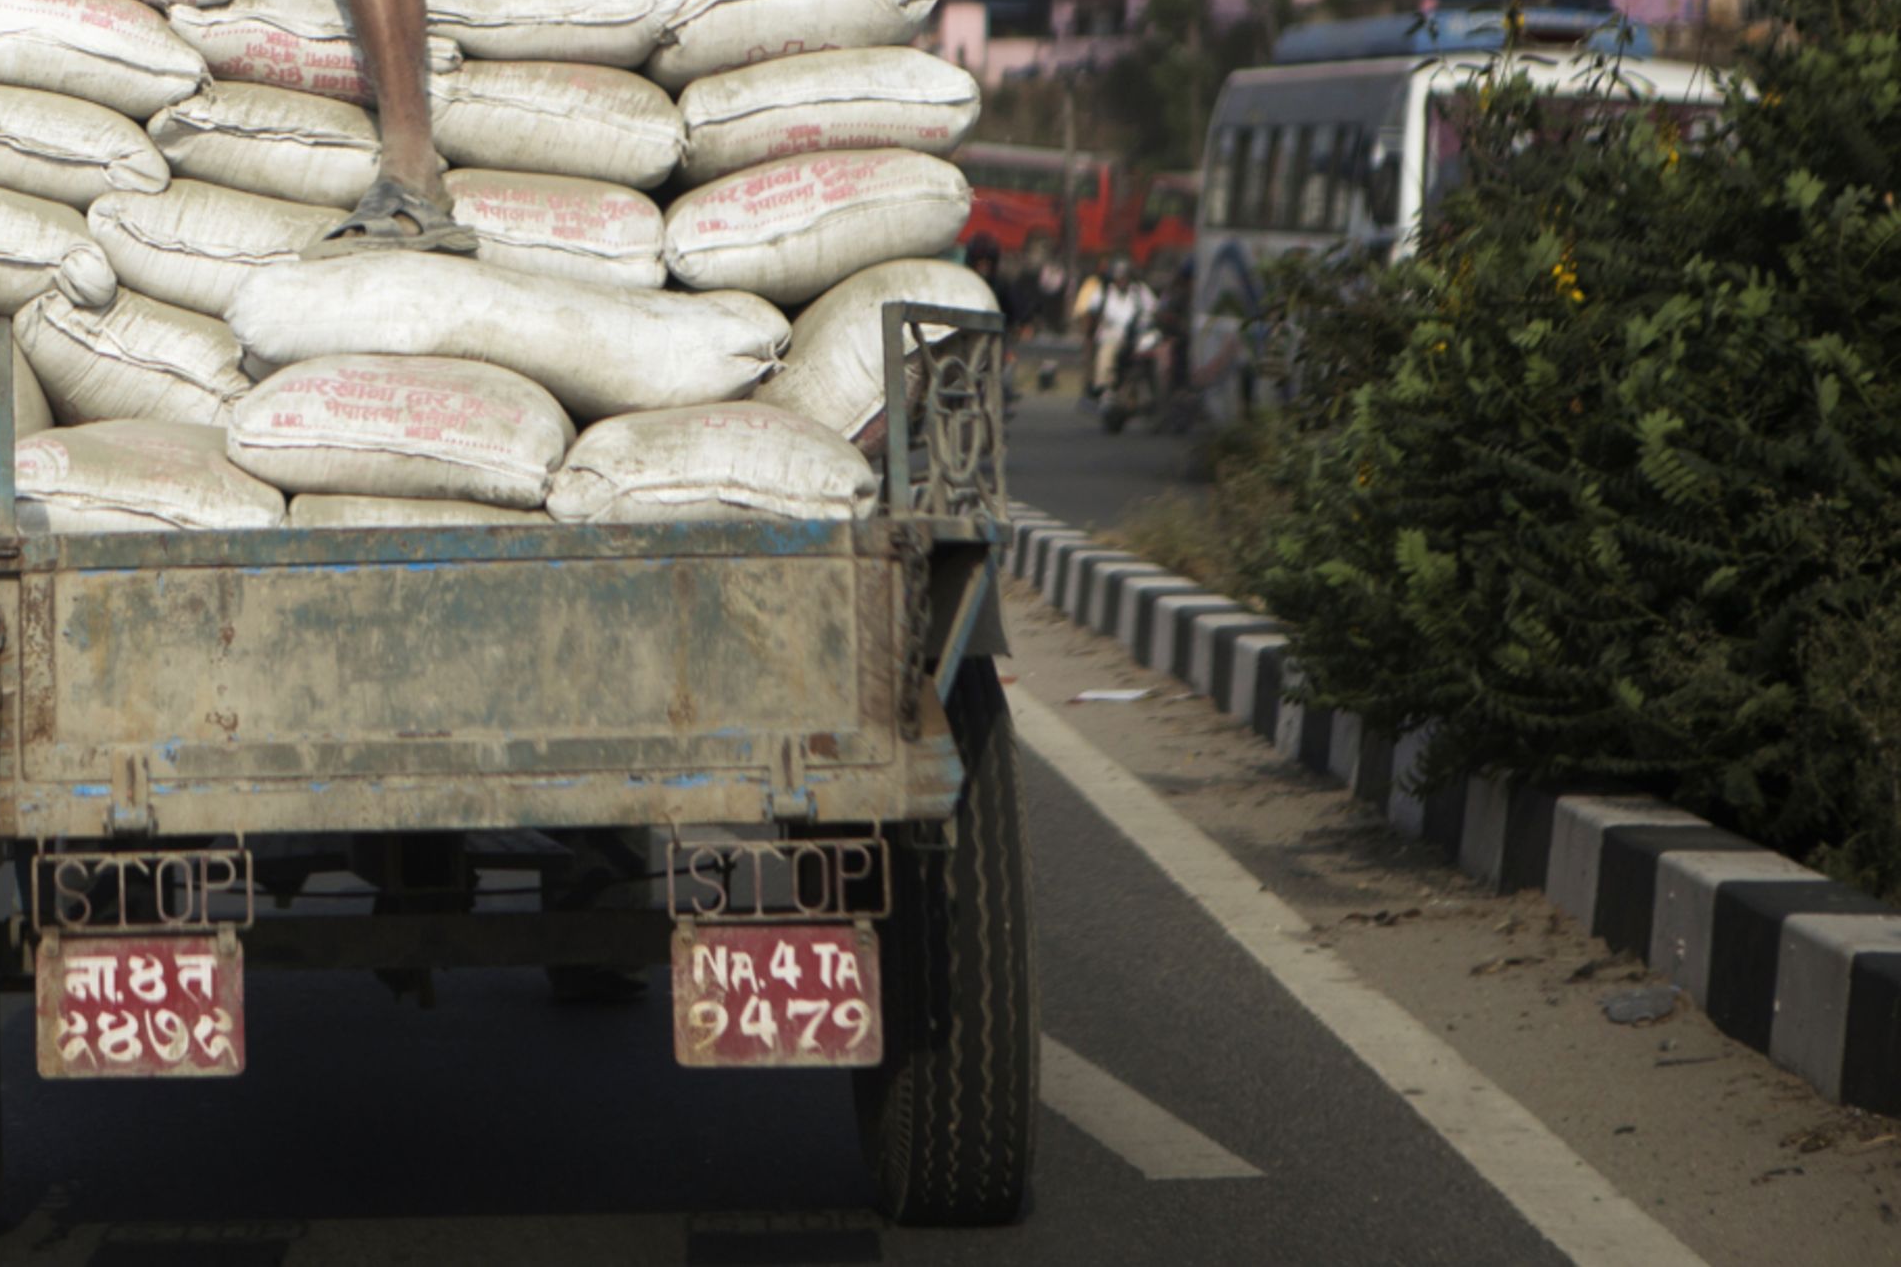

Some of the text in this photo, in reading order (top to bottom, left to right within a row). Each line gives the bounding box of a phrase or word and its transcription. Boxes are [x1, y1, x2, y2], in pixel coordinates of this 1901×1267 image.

[54, 855, 237, 928] STOP
[689, 839, 872, 917] STOP
[811, 942, 862, 991] TA
[688, 994, 872, 1049] 9479
